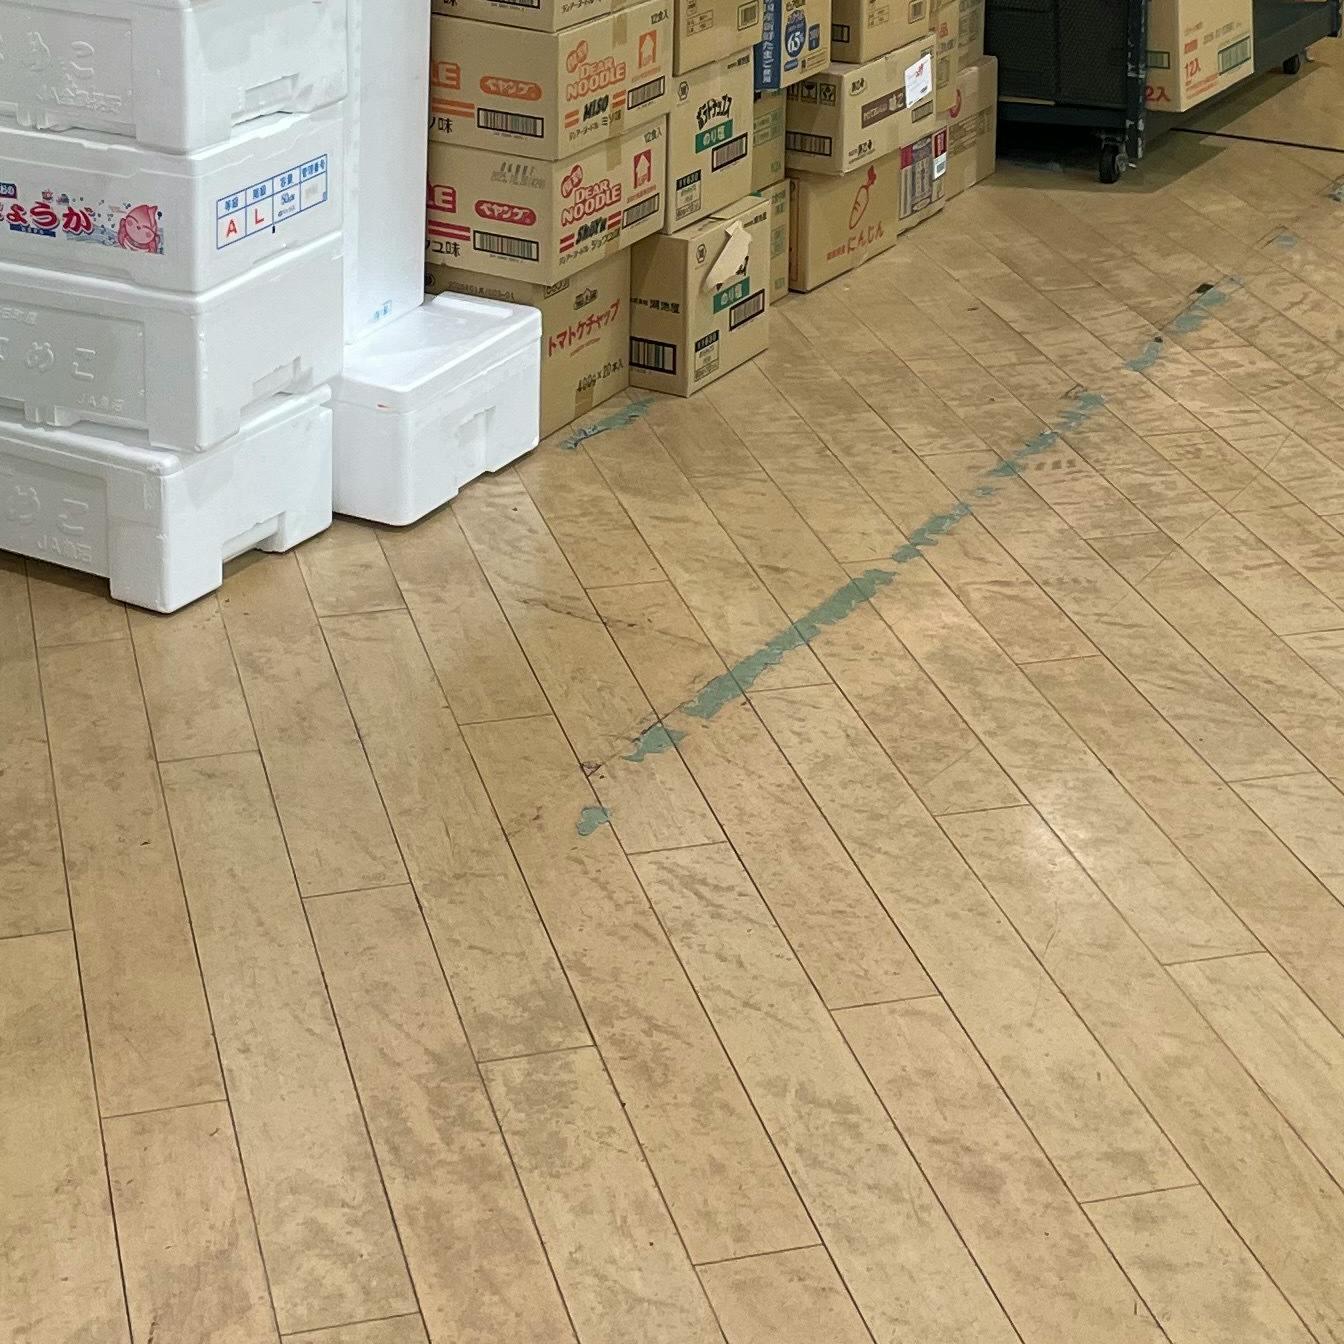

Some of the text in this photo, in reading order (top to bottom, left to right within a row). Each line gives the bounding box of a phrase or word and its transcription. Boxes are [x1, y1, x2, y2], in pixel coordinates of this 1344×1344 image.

[566, 61, 627, 101] NOODLE
[579, 57, 615, 79] DEAR
[485, 79, 536, 97] ペヤング
[583, 95, 609, 122] MISO
[575, 179, 610, 201] DEAR
[480, 203, 532, 222] ペヤング
[561, 183, 622, 227] NOODLE
[226, 209, 264, 238] A L
[847, 221, 884, 257] にんじん
[548, 299, 621, 356] トマトケチャップ
